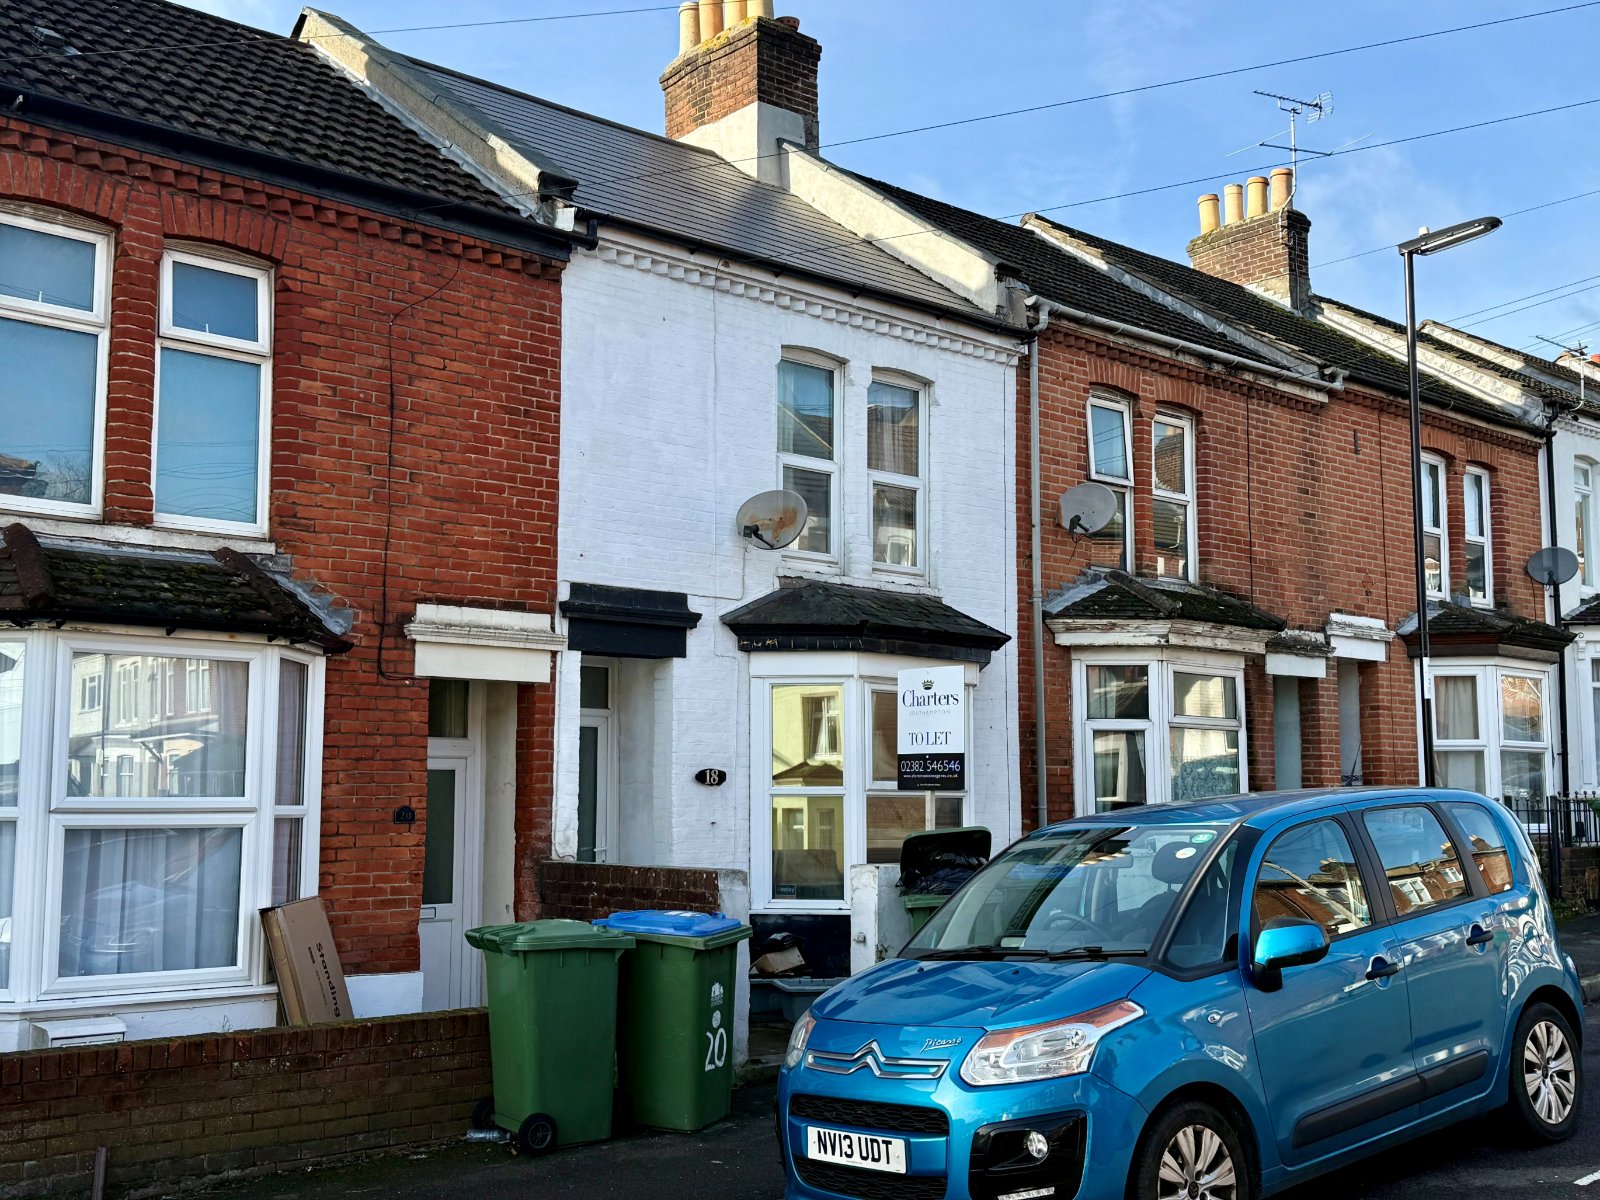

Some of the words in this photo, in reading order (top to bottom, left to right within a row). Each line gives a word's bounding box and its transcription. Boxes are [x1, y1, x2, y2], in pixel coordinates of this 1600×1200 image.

[902, 689, 960, 708] Charters
[908, 732, 924, 746] TO
[925, 731, 952, 746] LET
[900, 760, 924, 772] 02382
[926, 760, 961, 772] 546546
[705, 769, 719, 785] 18
[316, 942, 341, 1018] Standing
[704, 1027, 727, 1072] 20
[920, 1037, 962, 1054] Picasso
[817, 1129, 854, 1159] NV13
[858, 1136, 892, 1165] UDT
